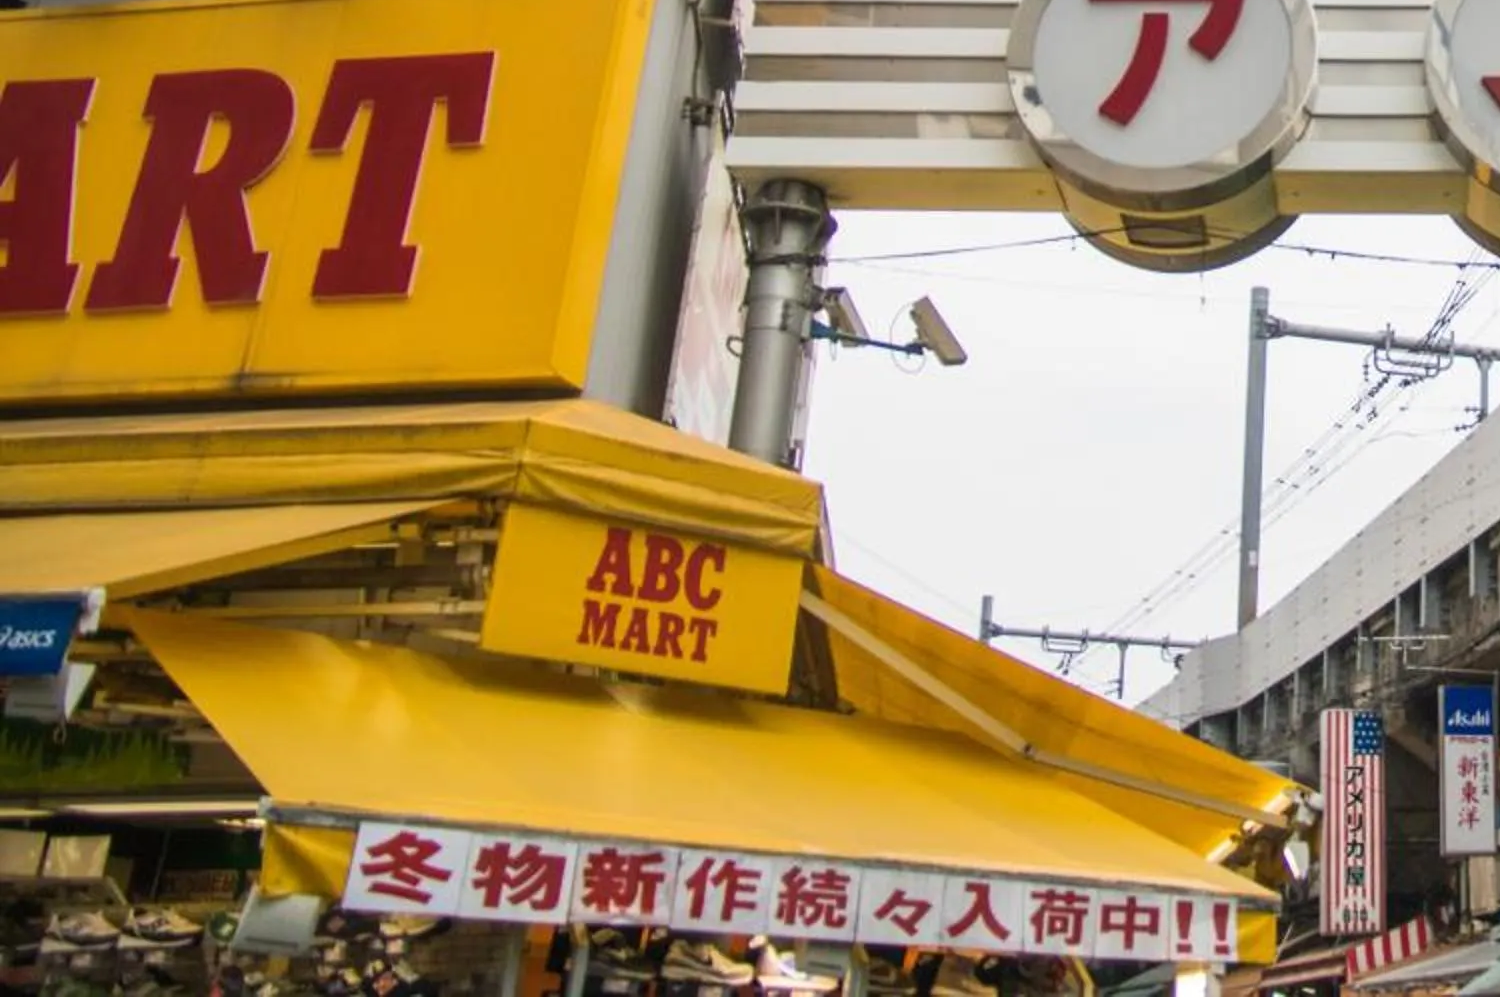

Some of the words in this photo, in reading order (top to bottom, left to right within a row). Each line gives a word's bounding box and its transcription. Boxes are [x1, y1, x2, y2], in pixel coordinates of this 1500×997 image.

[586, 528, 726, 609] ABC
[578, 599, 718, 664] MART
[1448, 708, 1491, 728] Asahi
